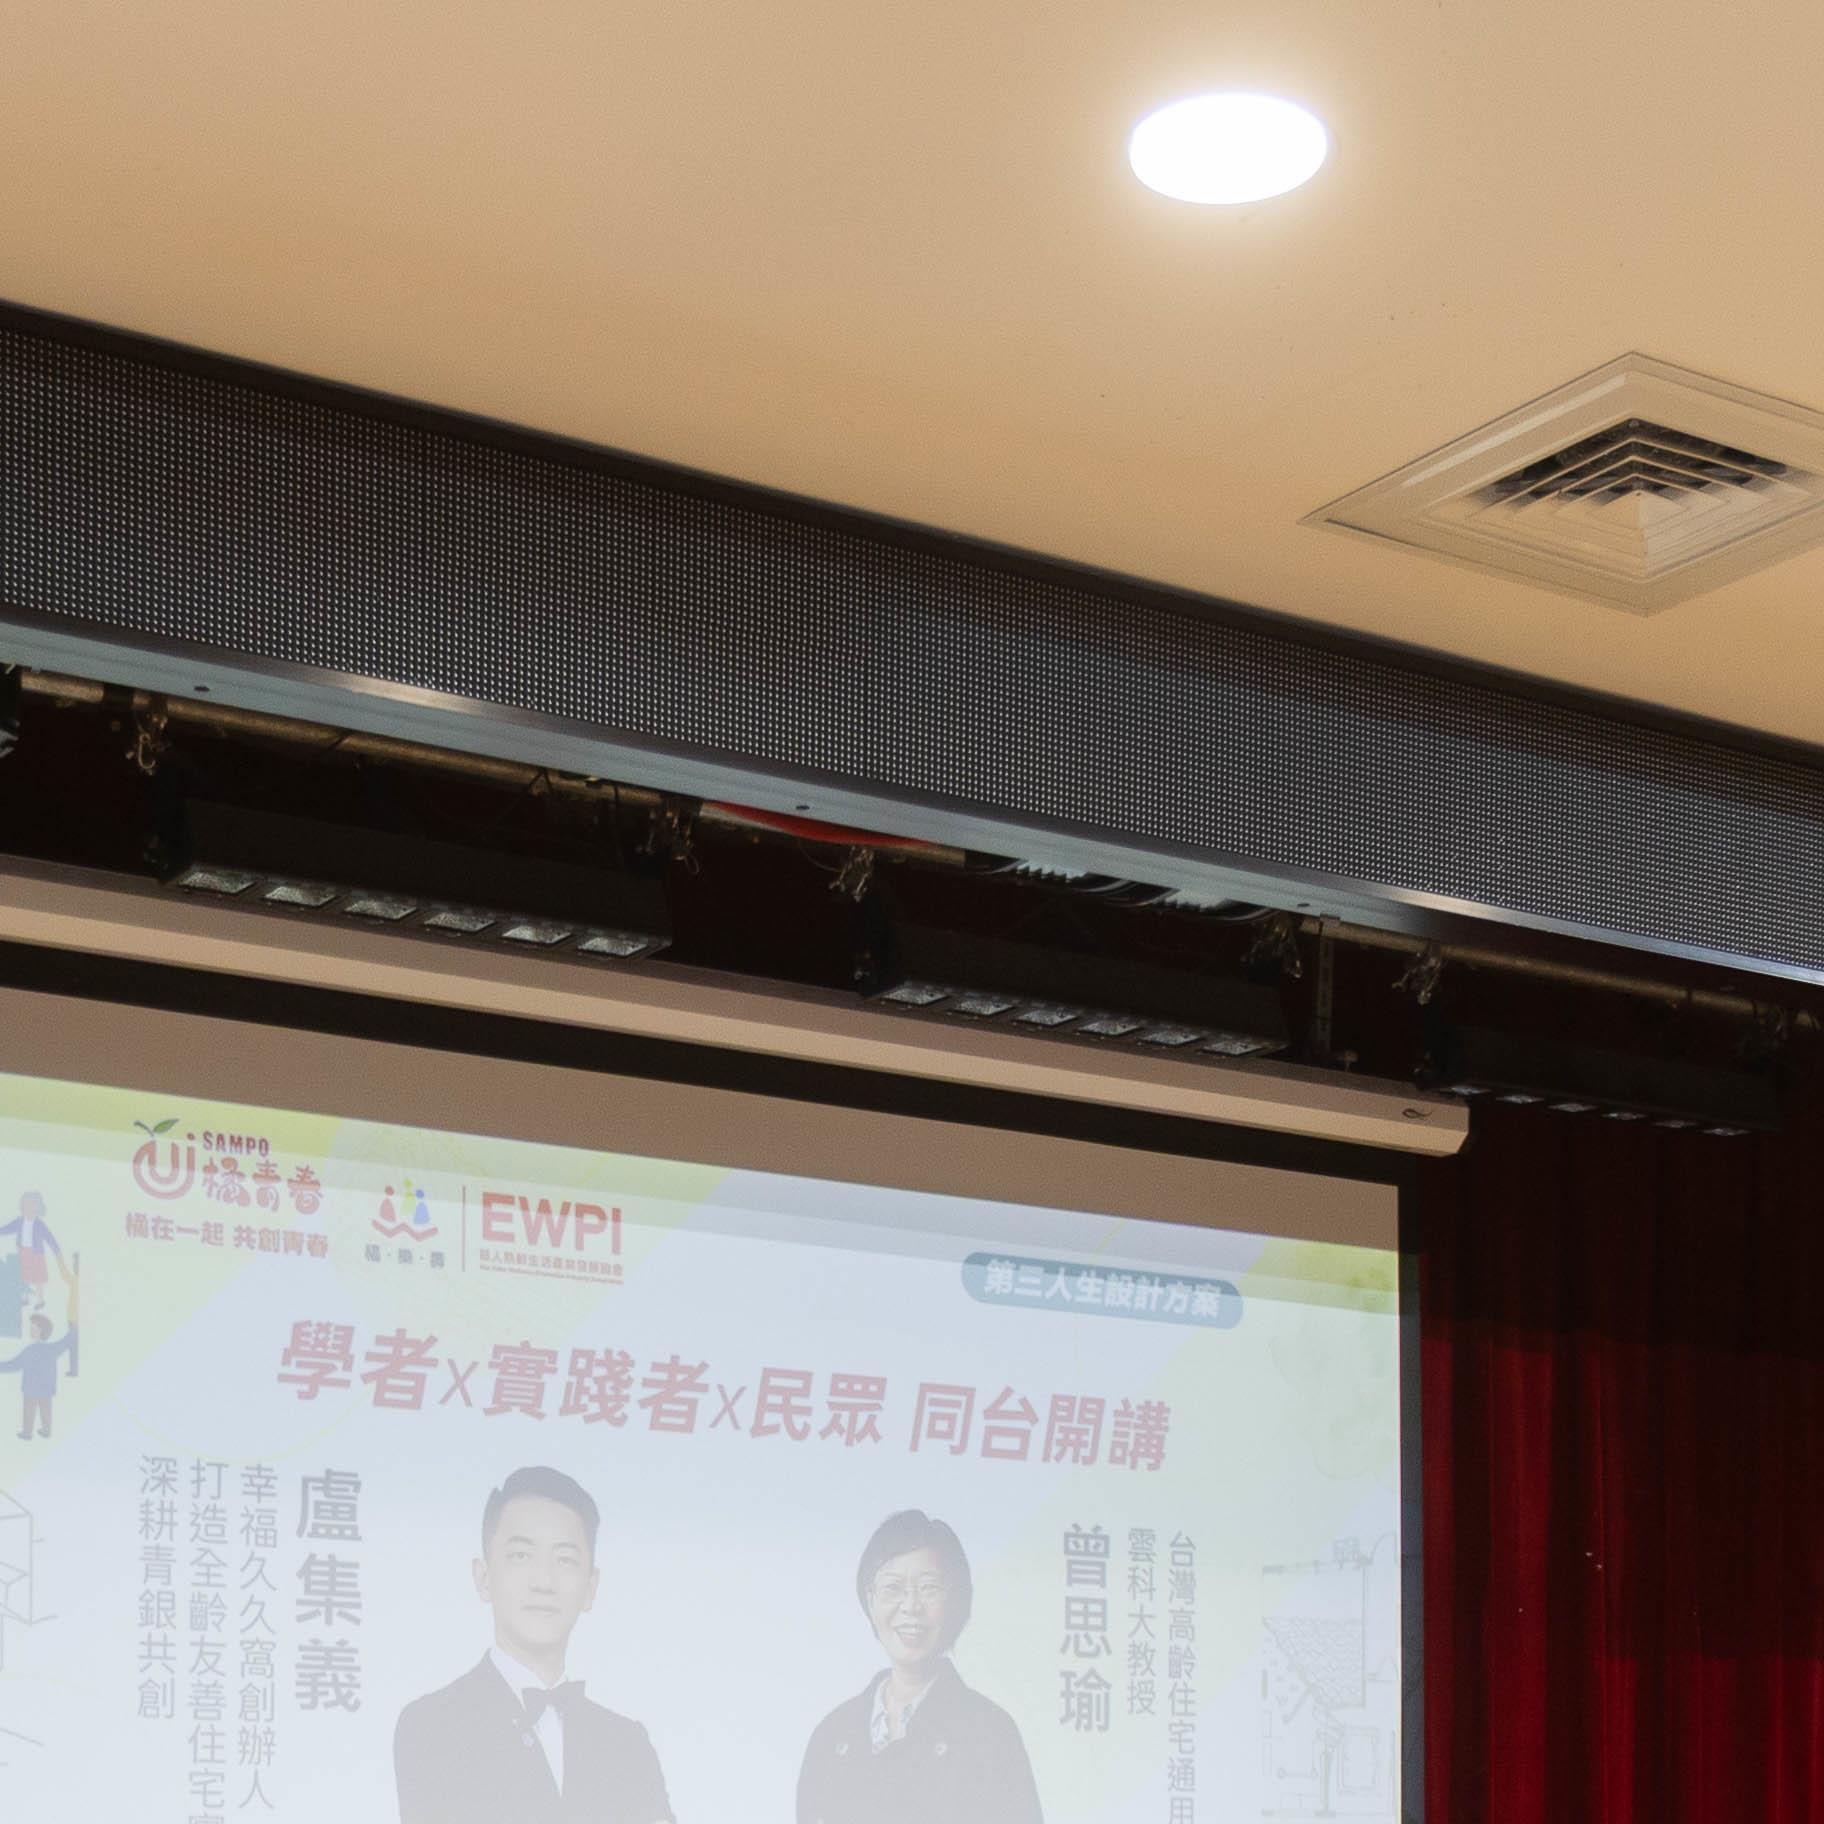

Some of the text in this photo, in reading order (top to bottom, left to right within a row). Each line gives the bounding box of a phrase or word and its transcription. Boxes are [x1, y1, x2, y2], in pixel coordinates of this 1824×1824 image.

[202, 1157, 324, 1215] 橘青春
[203, 1131, 269, 1157] SAMPO
[125, 1212, 328, 1258] 橘在一起 共創青春
[482, 1192, 622, 1255] EWPI
[984, 1259, 1222, 1317] 第三人生設計方案
[908, 1381, 1172, 1472] 同台開講
[137, 1455, 178, 1719] 深耕青銀共創
[295, 1468, 363, 1713] 盧集義
[1060, 1523, 1112, 1734] 曾思瑜
[1127, 1528, 1157, 1715] 雲科大教授
[238, 1463, 278, 1810] 幸福久久窩創辦人
